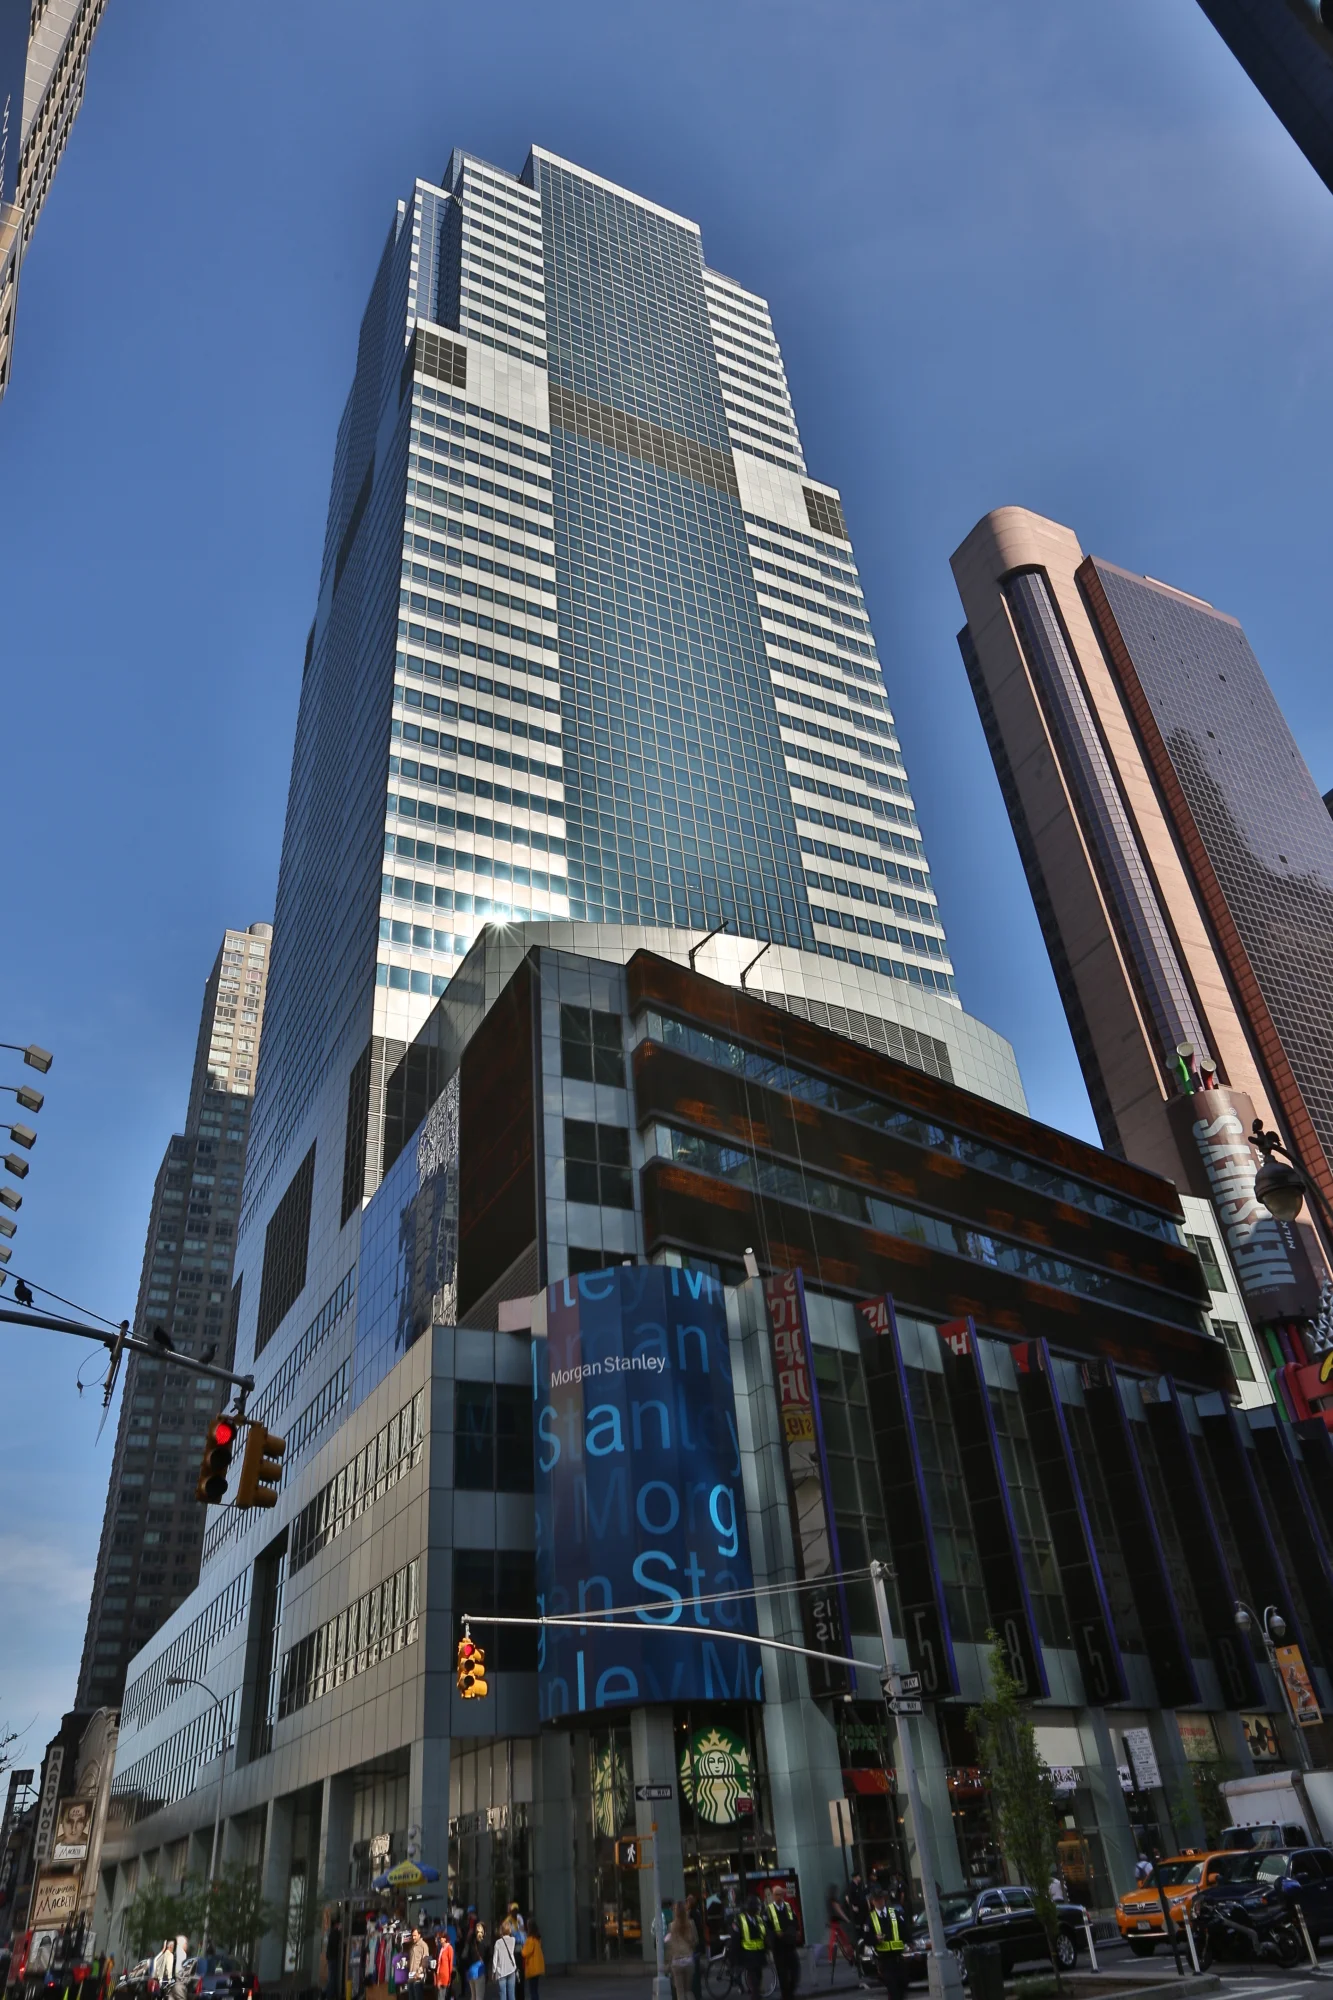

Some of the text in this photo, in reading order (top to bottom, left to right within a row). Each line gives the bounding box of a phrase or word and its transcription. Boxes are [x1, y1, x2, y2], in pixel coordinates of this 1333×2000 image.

[1192, 1117, 1297, 1292] HERSHEY'S
[1278, 1221, 1297, 1250] MILK
[550, 1353, 666, 1388] Morgan Stanley
[903, 1679, 917, 1689] WAY
[891, 1702, 917, 1710] ONE WAY
[36, 1750, 62, 1856] BARRYMORE
[641, 1788, 670, 1797] ONE WAY
